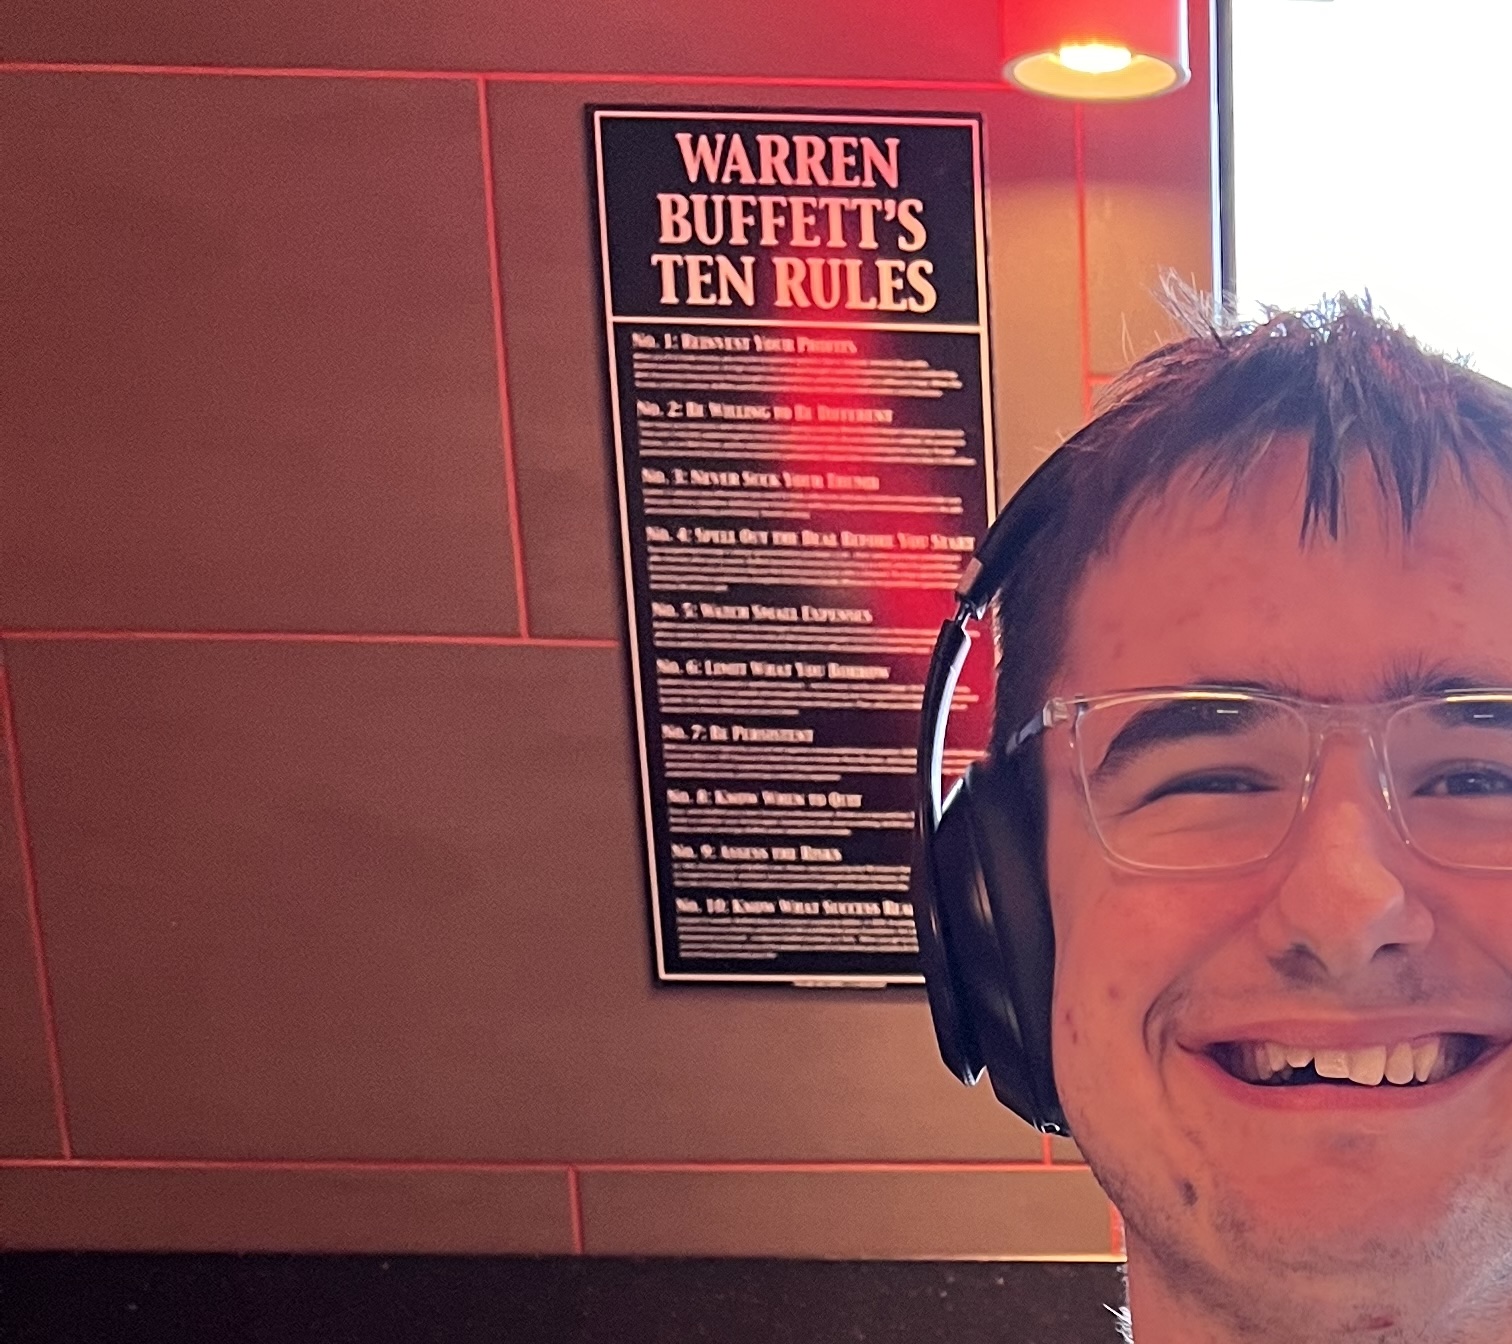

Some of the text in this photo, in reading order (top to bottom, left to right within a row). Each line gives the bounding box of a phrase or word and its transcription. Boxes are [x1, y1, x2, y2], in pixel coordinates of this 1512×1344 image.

[675, 132, 900, 188] WARREN
[657, 193, 928, 252] BUFFETT'S
[650, 253, 938, 314] TEN RULES
